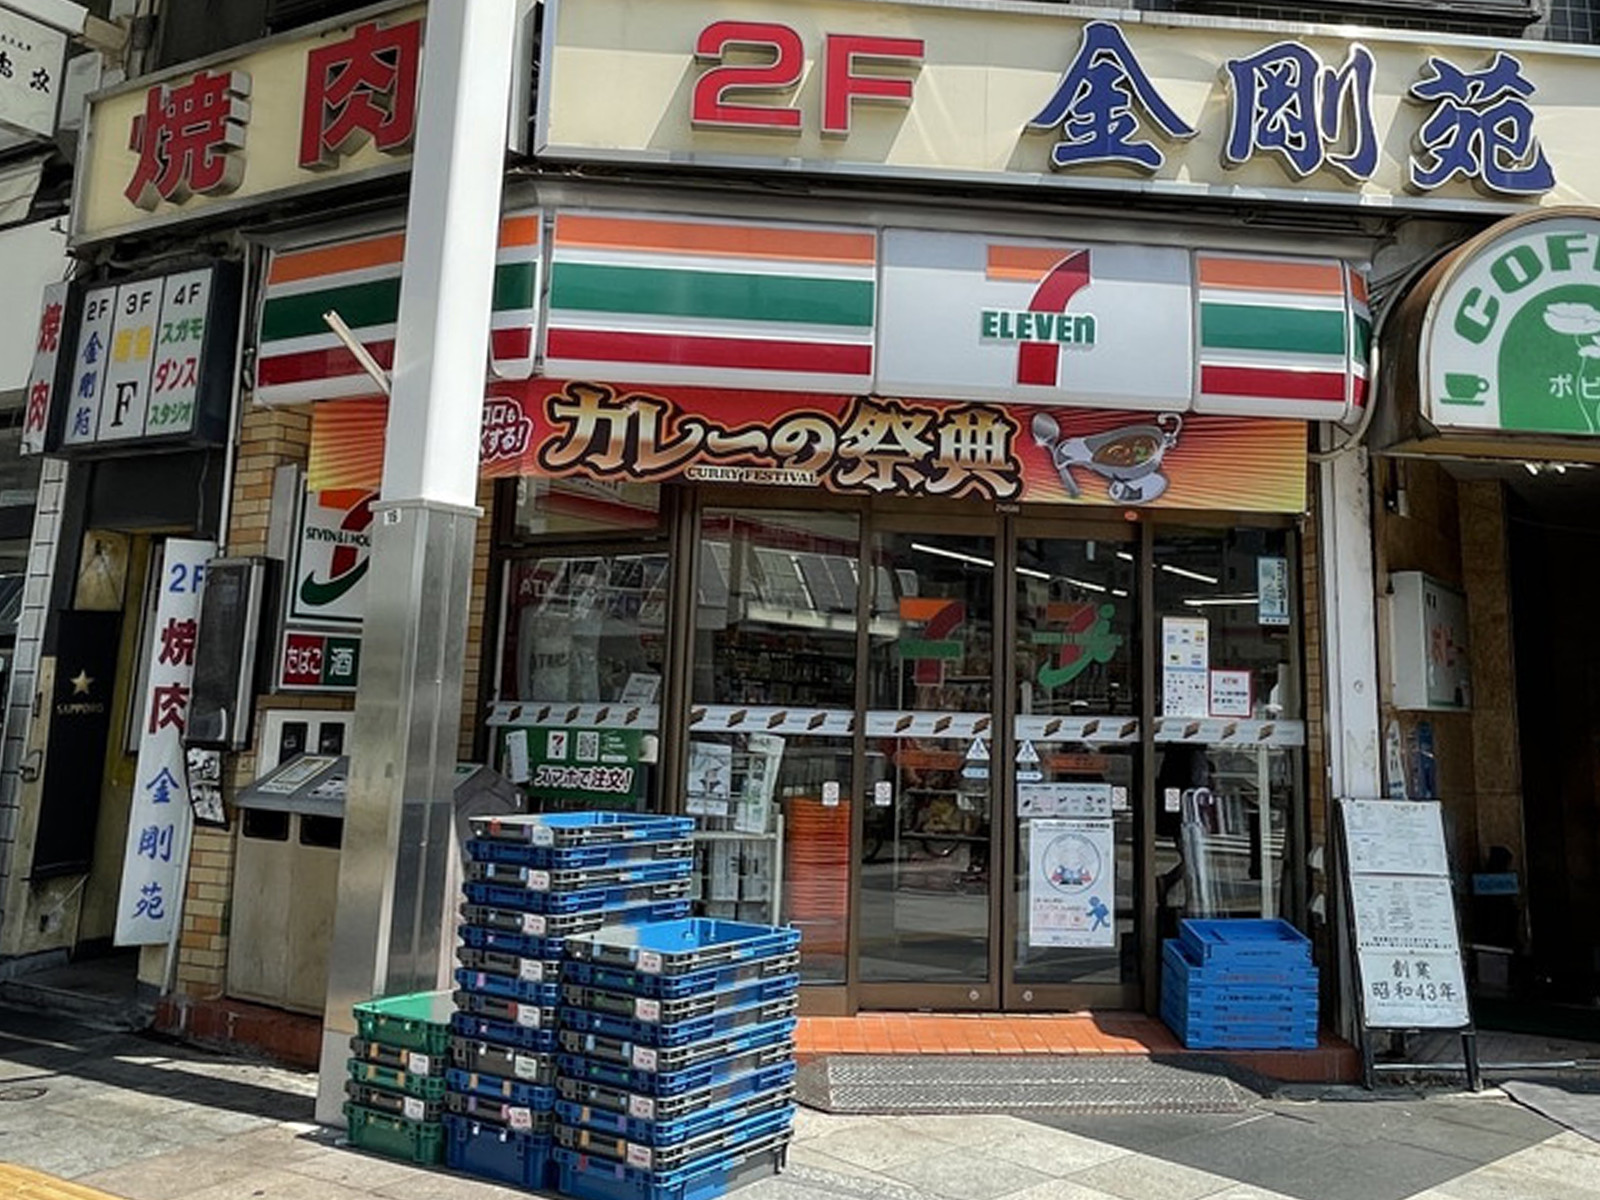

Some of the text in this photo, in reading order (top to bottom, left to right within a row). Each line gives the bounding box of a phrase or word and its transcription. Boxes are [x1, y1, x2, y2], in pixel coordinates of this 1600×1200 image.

[124, 20, 422, 204] 焼肉
[691, 19, 1556, 194] 2F 金剛苑
[126, 291, 152, 315] 3F
[173, 283, 201, 306] 4F
[1454, 233, 1600, 344] COF
[86, 298, 109, 321] 2F
[161, 318, 203, 344] スガモ
[25, 302, 63, 434] 焼肉
[155, 357, 197, 393] ダンス
[73, 331, 103, 437] 金剛苑
[111, 380, 138, 427] F
[149, 401, 192, 425] スタジオ
[540, 383, 1021, 498] カレーの祭典
[686, 466, 818, 485] CURRY FESTIVAL
[287, 646, 323, 675] たばこ
[330, 648, 355, 676] 酒
[534, 764, 634, 794] スマホで注文!
[132, 767, 180, 920] 金剛苑
[1371, 980, 1457, 1002] 昭和43年
